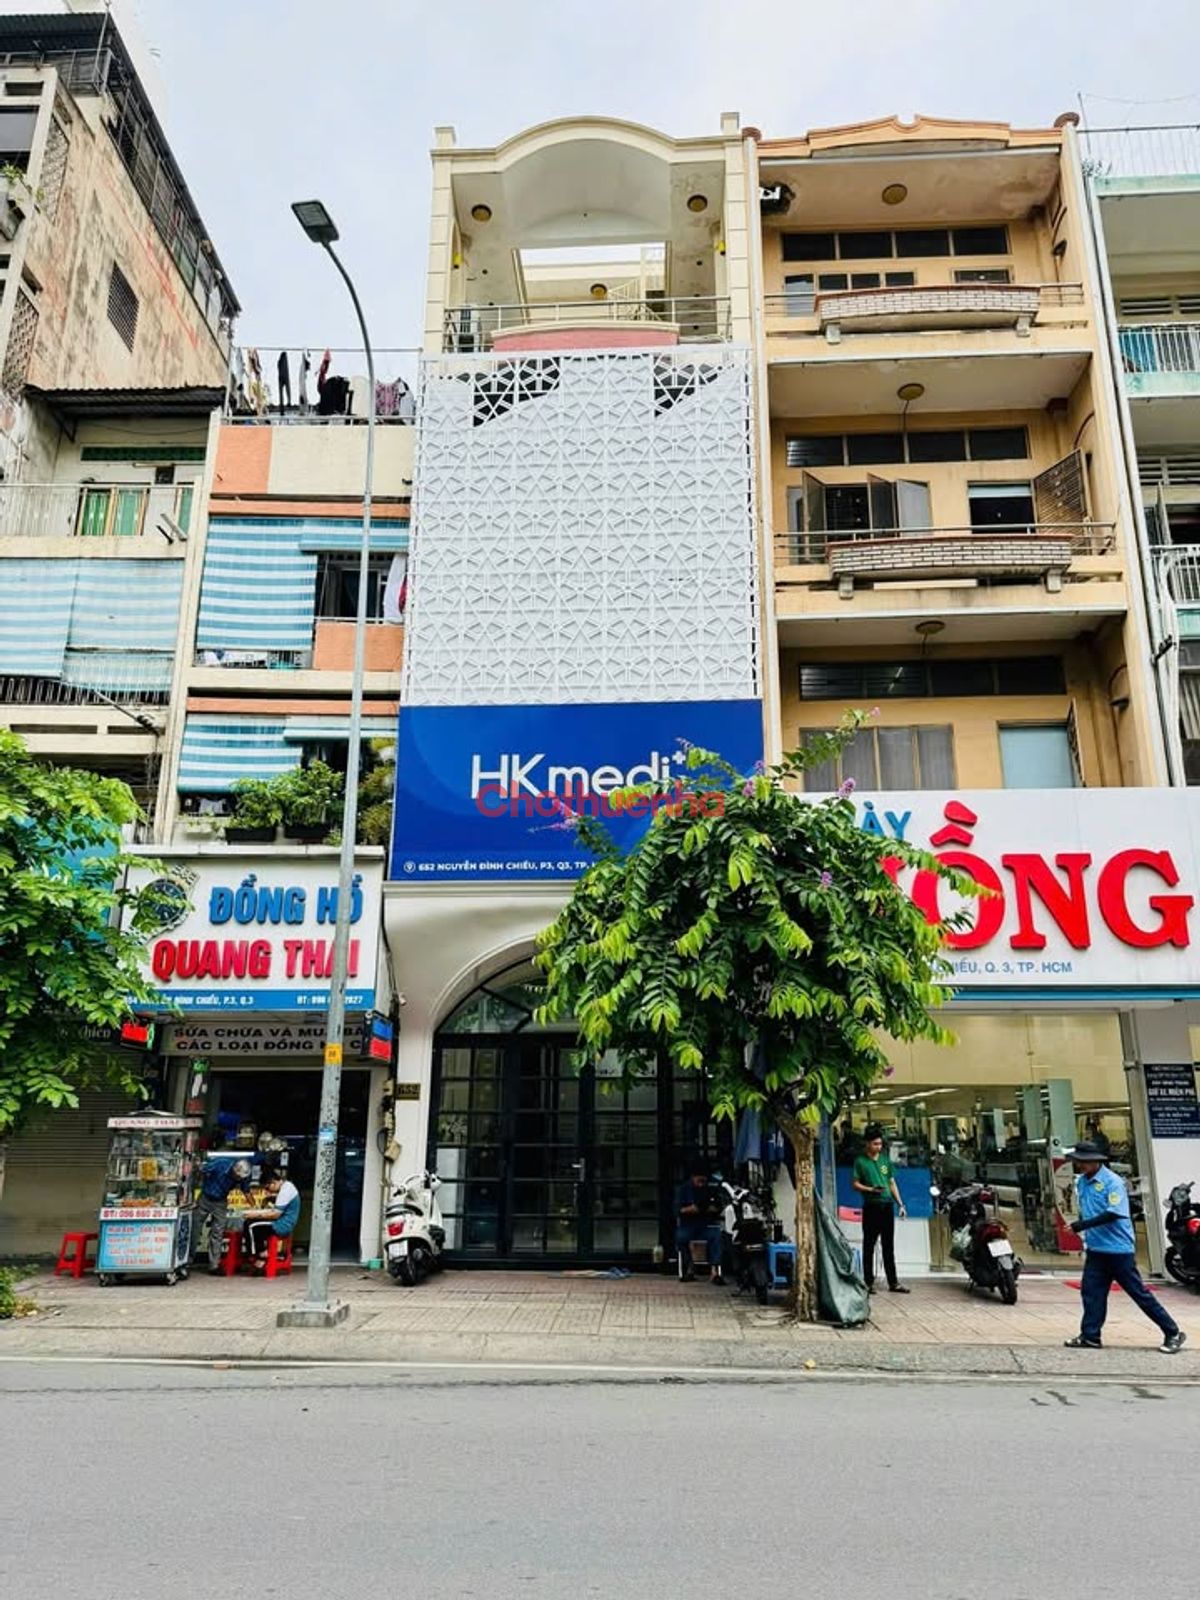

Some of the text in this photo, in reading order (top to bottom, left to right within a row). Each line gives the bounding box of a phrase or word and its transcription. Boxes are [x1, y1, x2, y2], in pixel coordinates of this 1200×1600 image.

[152, 939, 272, 982] QUANG
[1041, 961, 1073, 974] HCM
[218, 1041, 258, 1053] LOẠI
